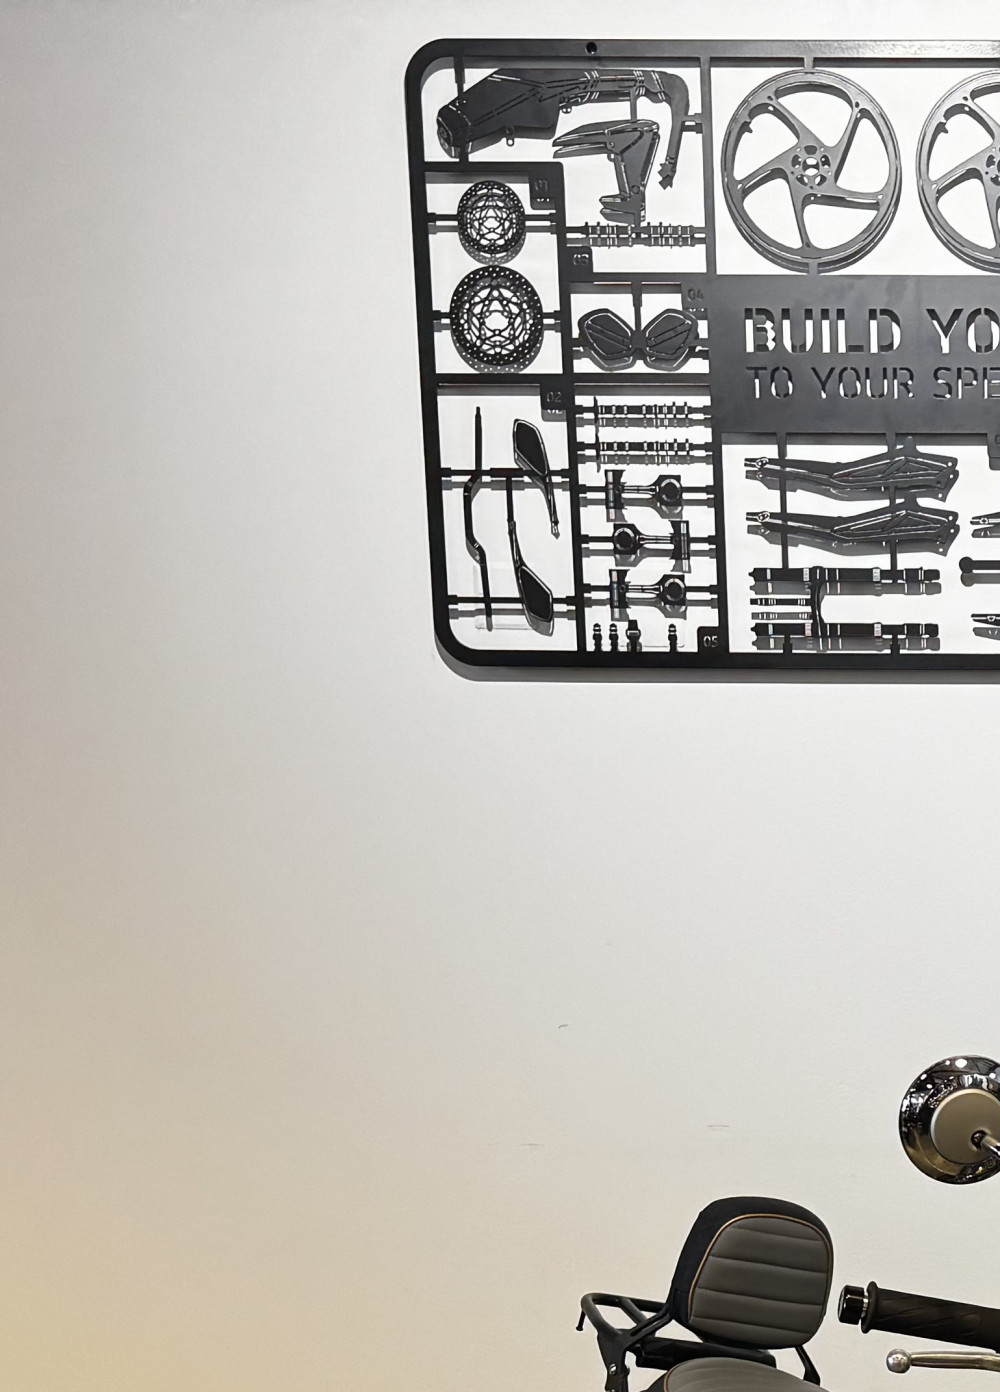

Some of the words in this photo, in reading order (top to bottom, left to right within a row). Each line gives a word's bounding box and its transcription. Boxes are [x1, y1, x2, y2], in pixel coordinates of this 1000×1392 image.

[744, 307, 901, 354] BUILD
[745, 366, 794, 399] TO
[811, 366, 915, 399] YOUR
[546, 391, 562, 403] 02
[703, 635, 718, 648] 05
